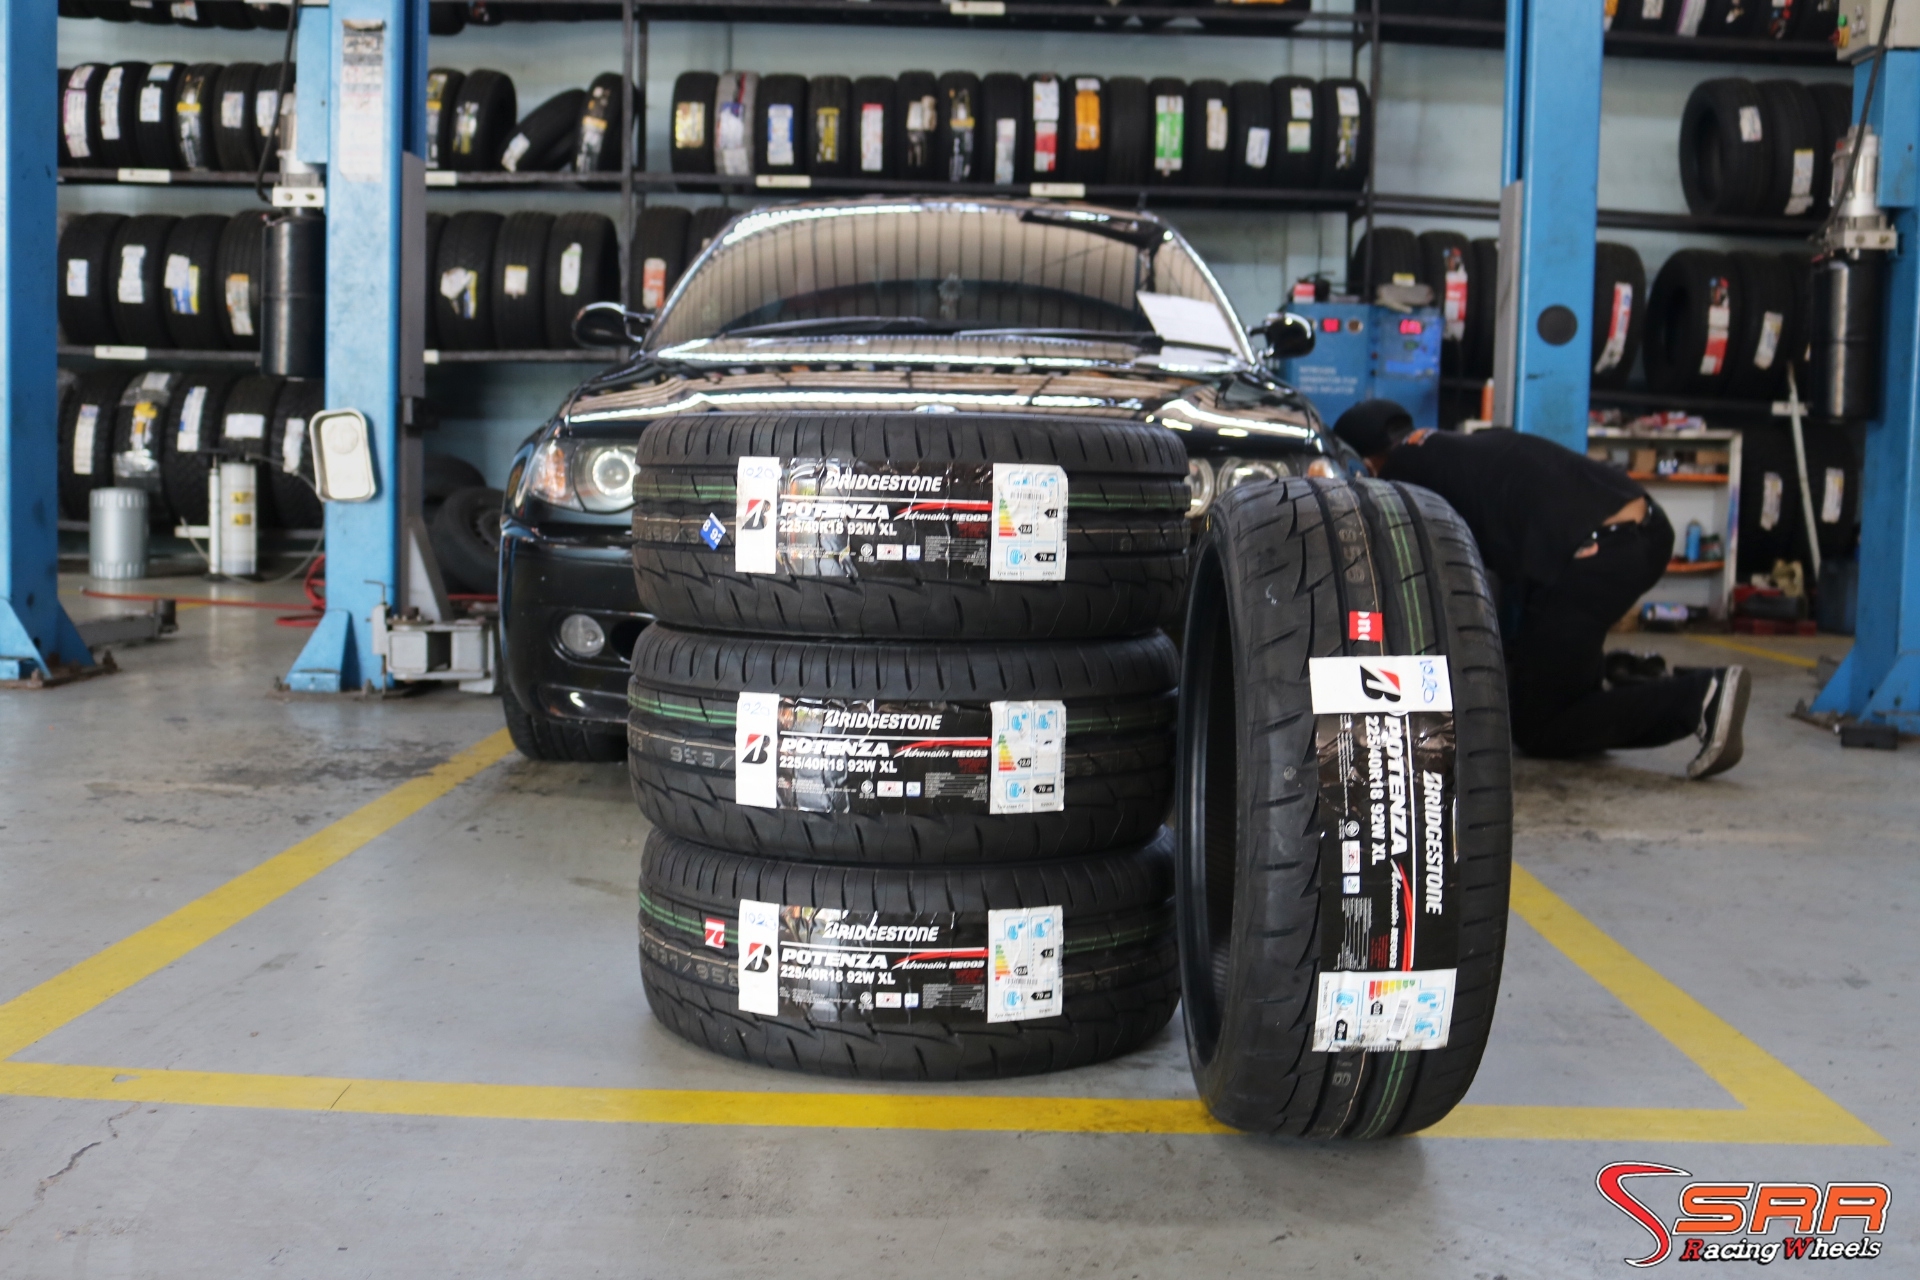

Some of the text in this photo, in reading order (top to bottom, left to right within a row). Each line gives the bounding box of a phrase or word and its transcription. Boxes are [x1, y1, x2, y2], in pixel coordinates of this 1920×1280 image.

[822, 471, 943, 492] BRIDGESTONE
[780, 502, 889, 520] POTENZA
[779, 519, 898, 536] 225/40R18 92W XL
[823, 711, 942, 730] BRIDGESTONE
[780, 738, 889, 757] POTENZA
[779, 756, 898, 773] 225/40R18 92W XL
[1365, 715, 1386, 865] 225/40R18 92W XL
[1384, 715, 1407, 855] POTENZA
[1423, 769, 1443, 915] BRIDGESTONE
[822, 922, 940, 941] BRIDGESTONE
[781, 948, 888, 969] POTENZA
[780, 965, 896, 985] 225/40R18 92W XL
